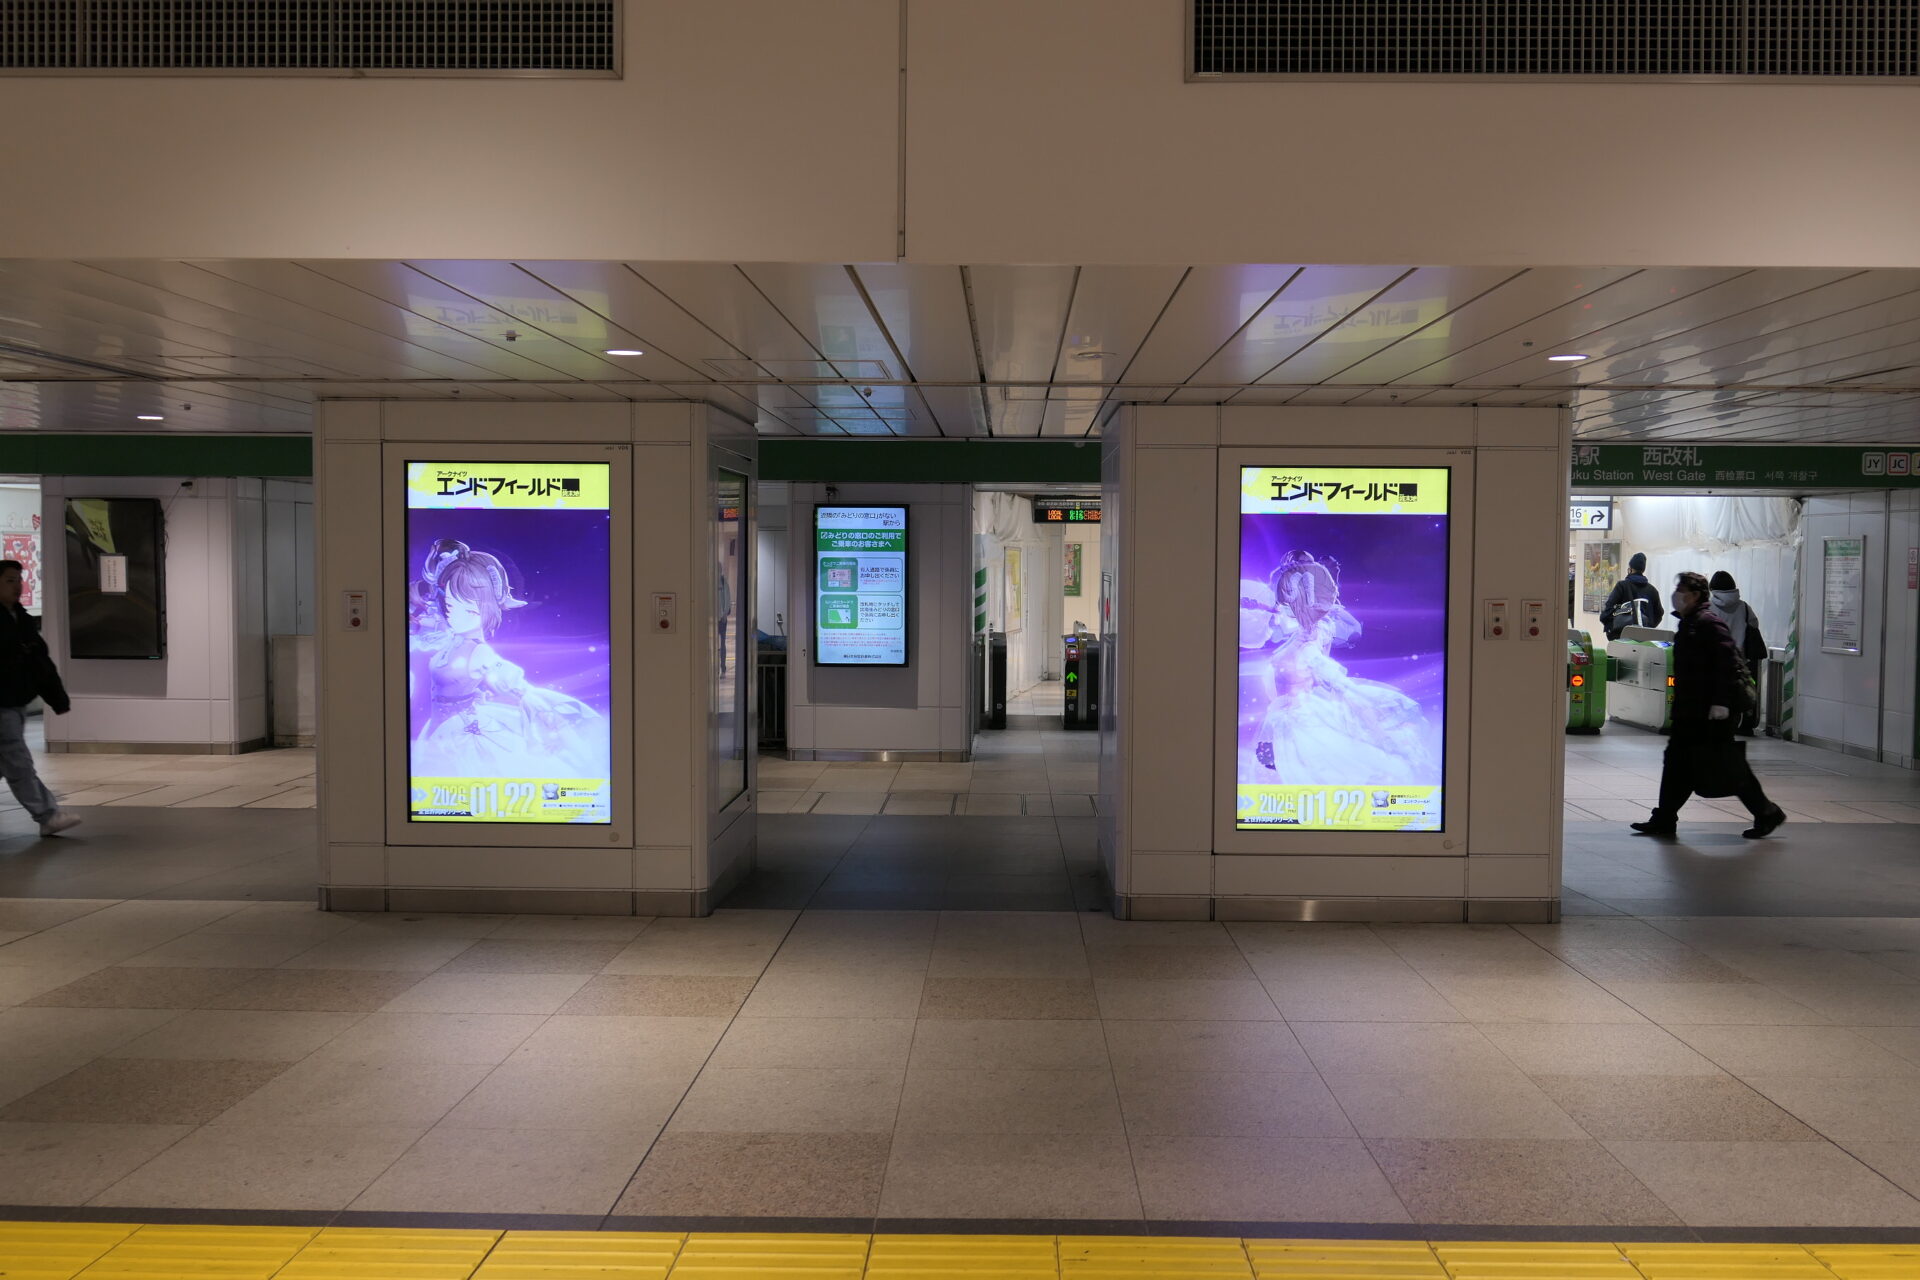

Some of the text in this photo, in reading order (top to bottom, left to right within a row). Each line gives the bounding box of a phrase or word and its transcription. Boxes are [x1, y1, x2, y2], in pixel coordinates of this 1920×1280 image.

[1642, 446, 1703, 466] 西改札
[1867, 458, 1880, 469] JY
[1891, 458, 1905, 469] JC
[1593, 469, 1634, 481] Station
[1642, 469, 1673, 481] West
[1677, 469, 1706, 481] Gate
[437, 477, 562, 497] エンドフィールド
[1271, 482, 1399, 502] エンドフィールド
[1570, 508, 1582, 519] 16
[883, 519, 901, 527] 駅から
[828, 531, 902, 540] みどりの窓口のご利用で
[831, 540, 892, 548] ご乗車のお客さまへ
[470, 782, 536, 817] 01.22
[1259, 789, 1365, 826] 2026 01.22
